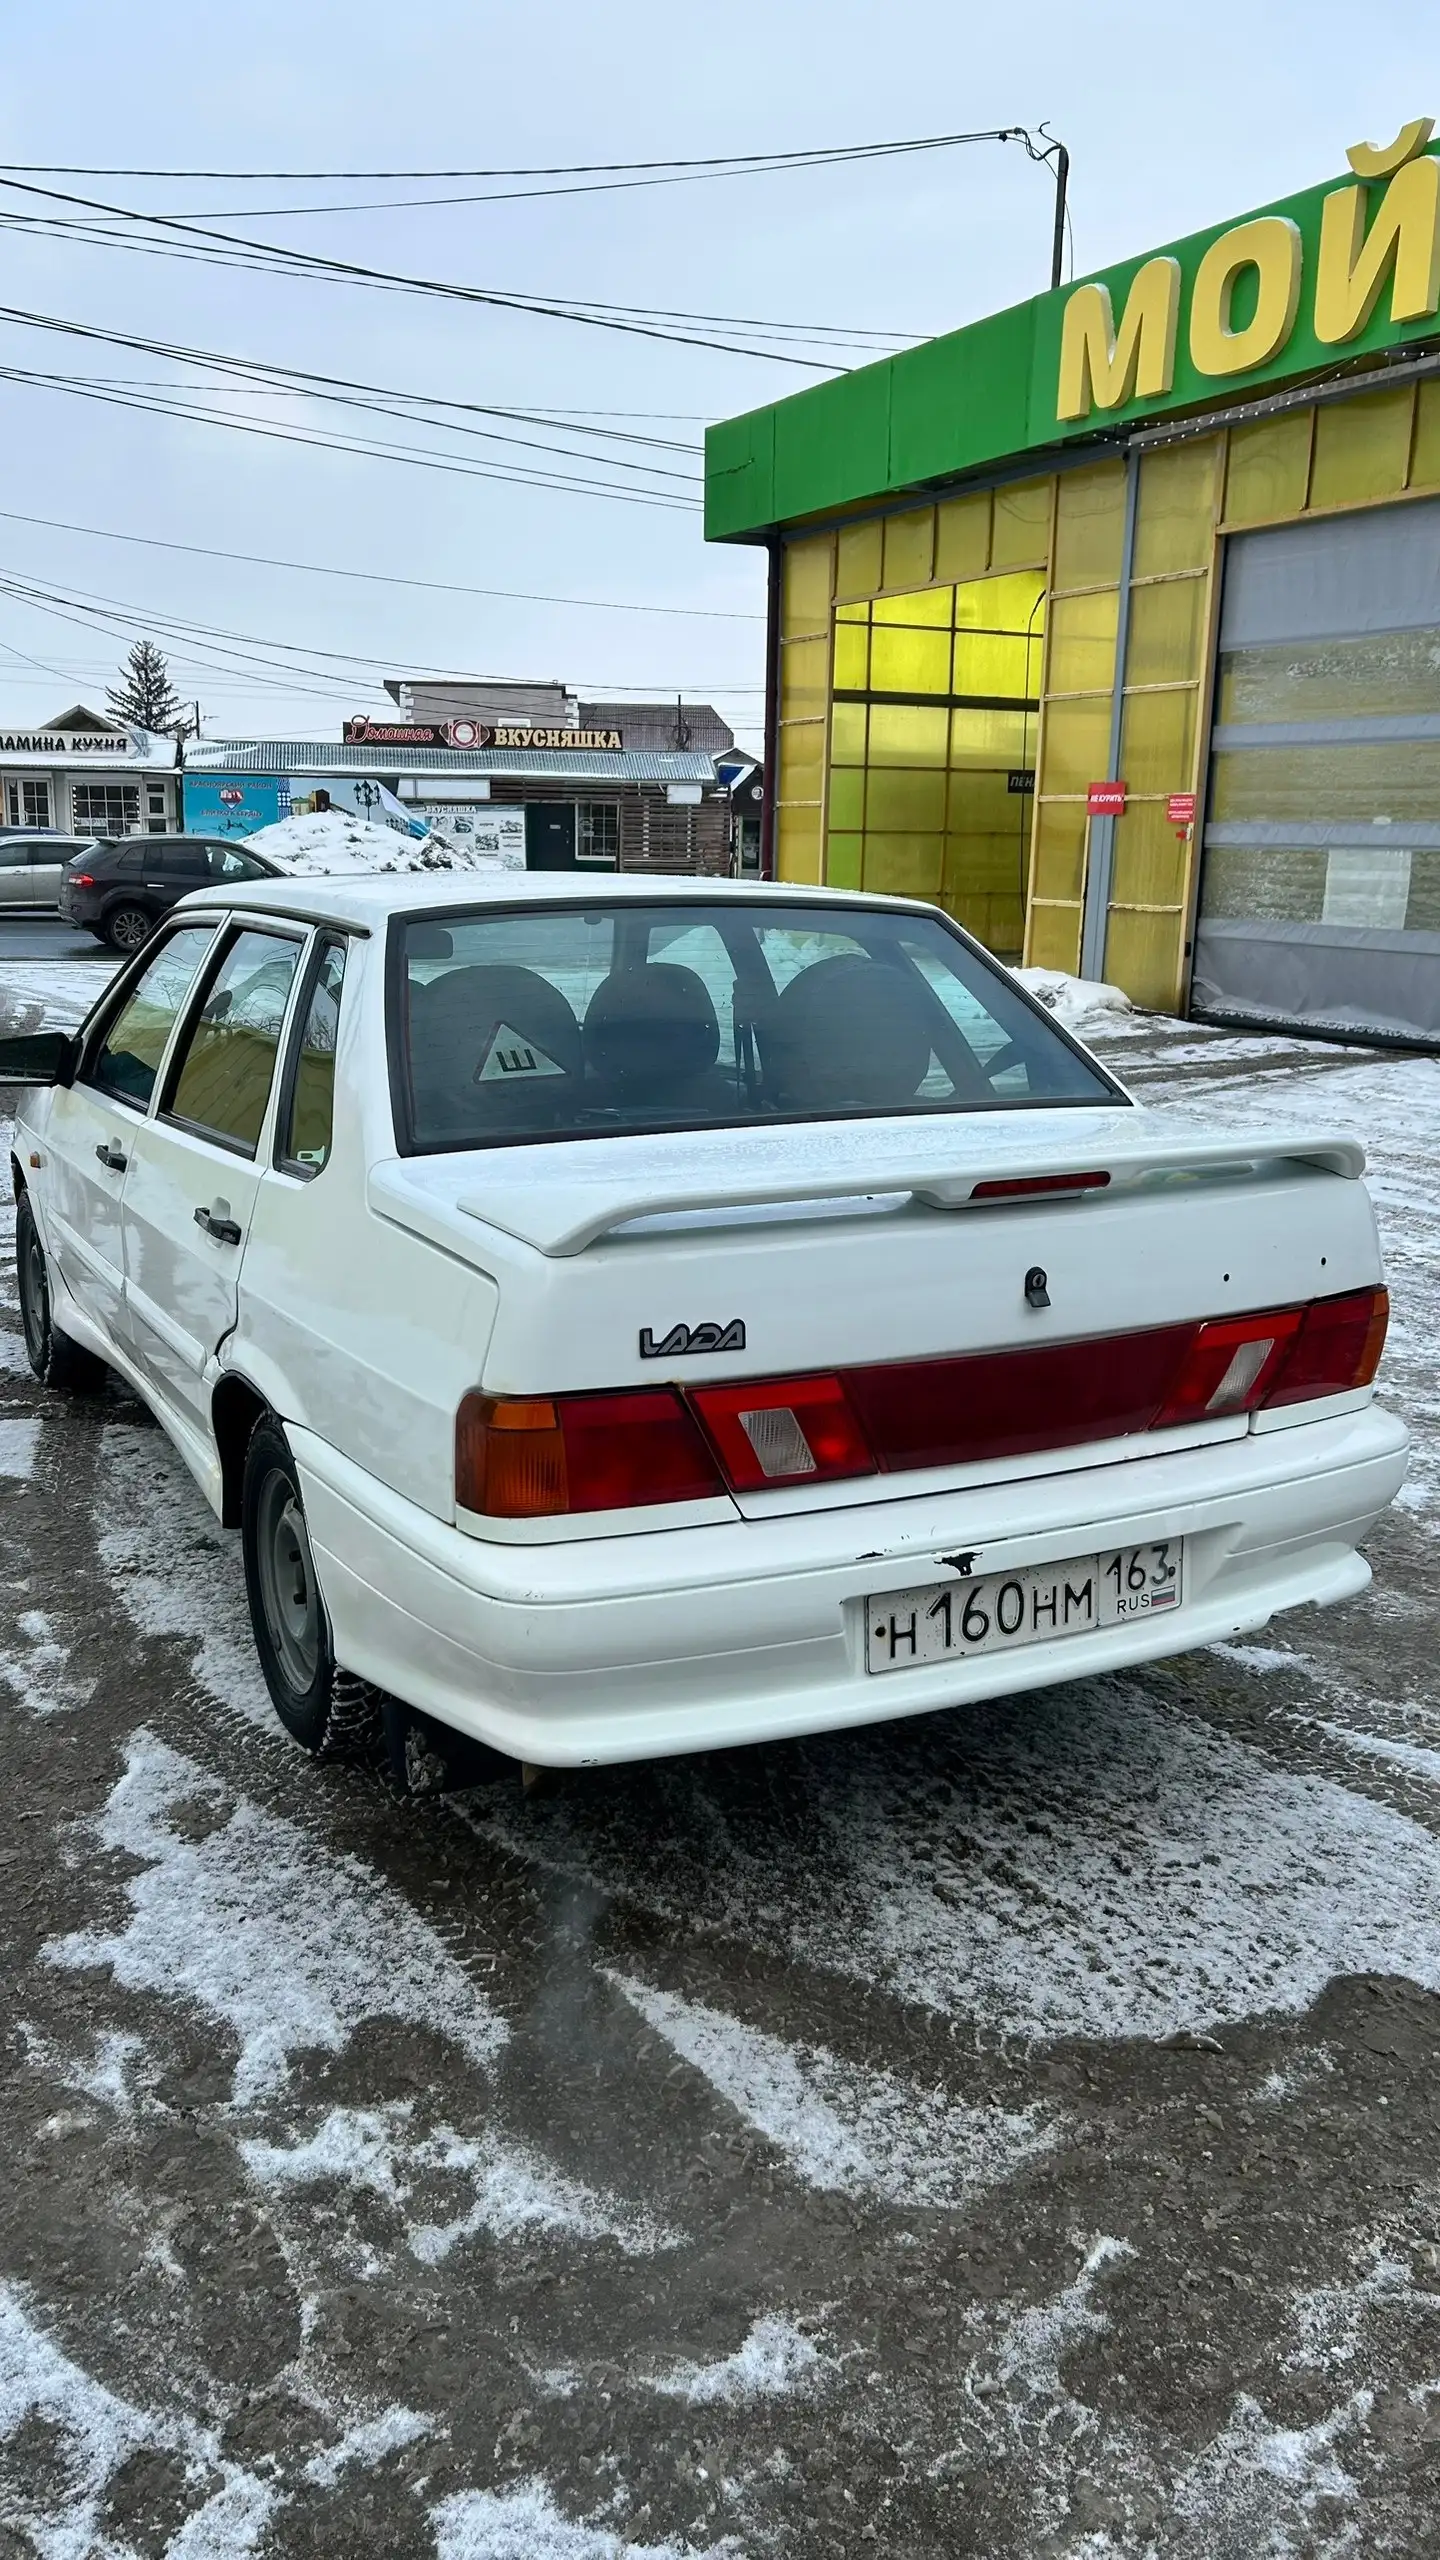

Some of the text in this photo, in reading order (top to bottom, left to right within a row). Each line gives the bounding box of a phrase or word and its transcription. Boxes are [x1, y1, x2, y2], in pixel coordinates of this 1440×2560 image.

[1056, 117, 1440, 421] МОЙ
[346, 715, 622, 748] Домашняя ВКУСНЯШКА
[72, 737, 128, 752] КУХНЯ
[1010, 776, 1036, 788] ПЕН
[1099, 793, 1123, 803] КУРИТЬ
[426, 805, 477, 814] ВКУСНЯШКА
[496, 1048, 538, 1072] Ш
[640, 1318, 746, 1358] LADA
[888, 1544, 1171, 1660] Н160НМ 163
[1116, 1593, 1151, 1614] RUS
